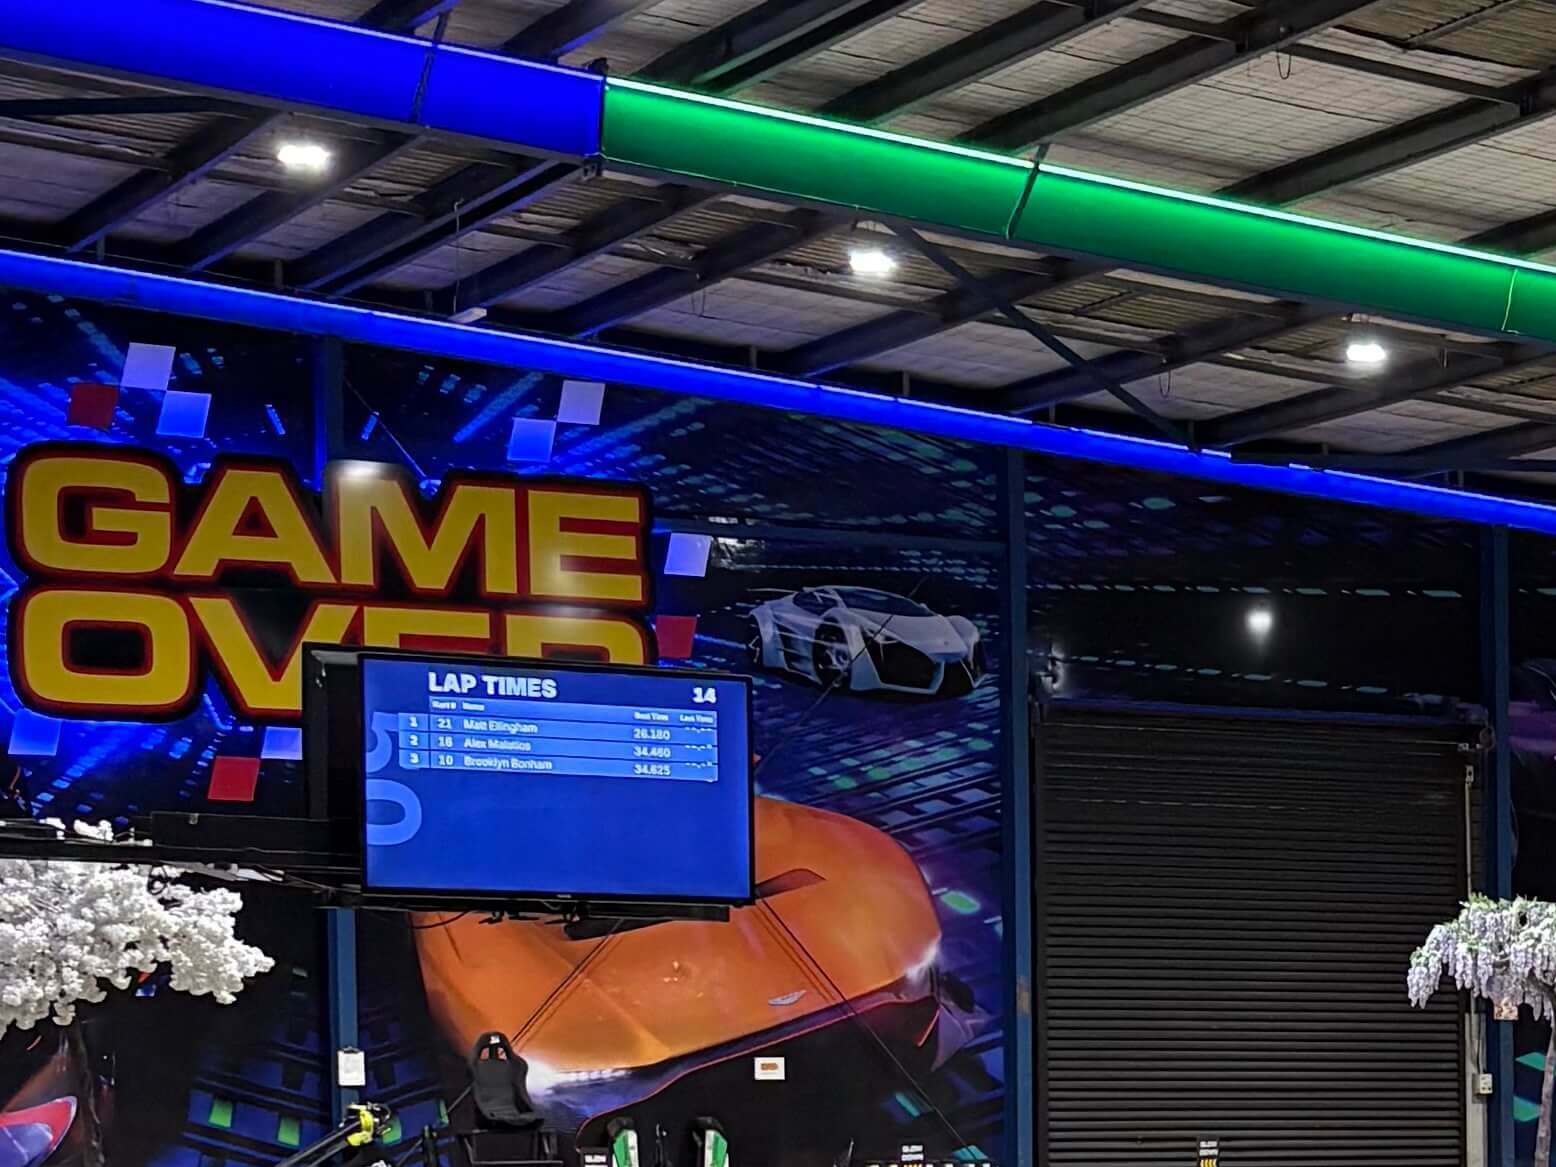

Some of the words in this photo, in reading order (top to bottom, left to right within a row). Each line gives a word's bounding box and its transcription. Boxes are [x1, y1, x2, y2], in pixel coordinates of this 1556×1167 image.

[21, 456, 643, 602] GAME
[428, 671, 477, 693] LAP
[481, 675, 557, 699] TIMES
[692, 687, 717, 703] 14
[408, 717, 418, 728] 1
[437, 718, 452, 730] 21
[463, 719, 488, 731] Matt
[409, 734, 419, 746] 2
[463, 738, 487, 749] Alex
[409, 752, 420, 764] 3
[438, 754, 454, 766] 10
[463, 755, 510, 769] Brooklyn
[511, 758, 553, 770] Bonham
